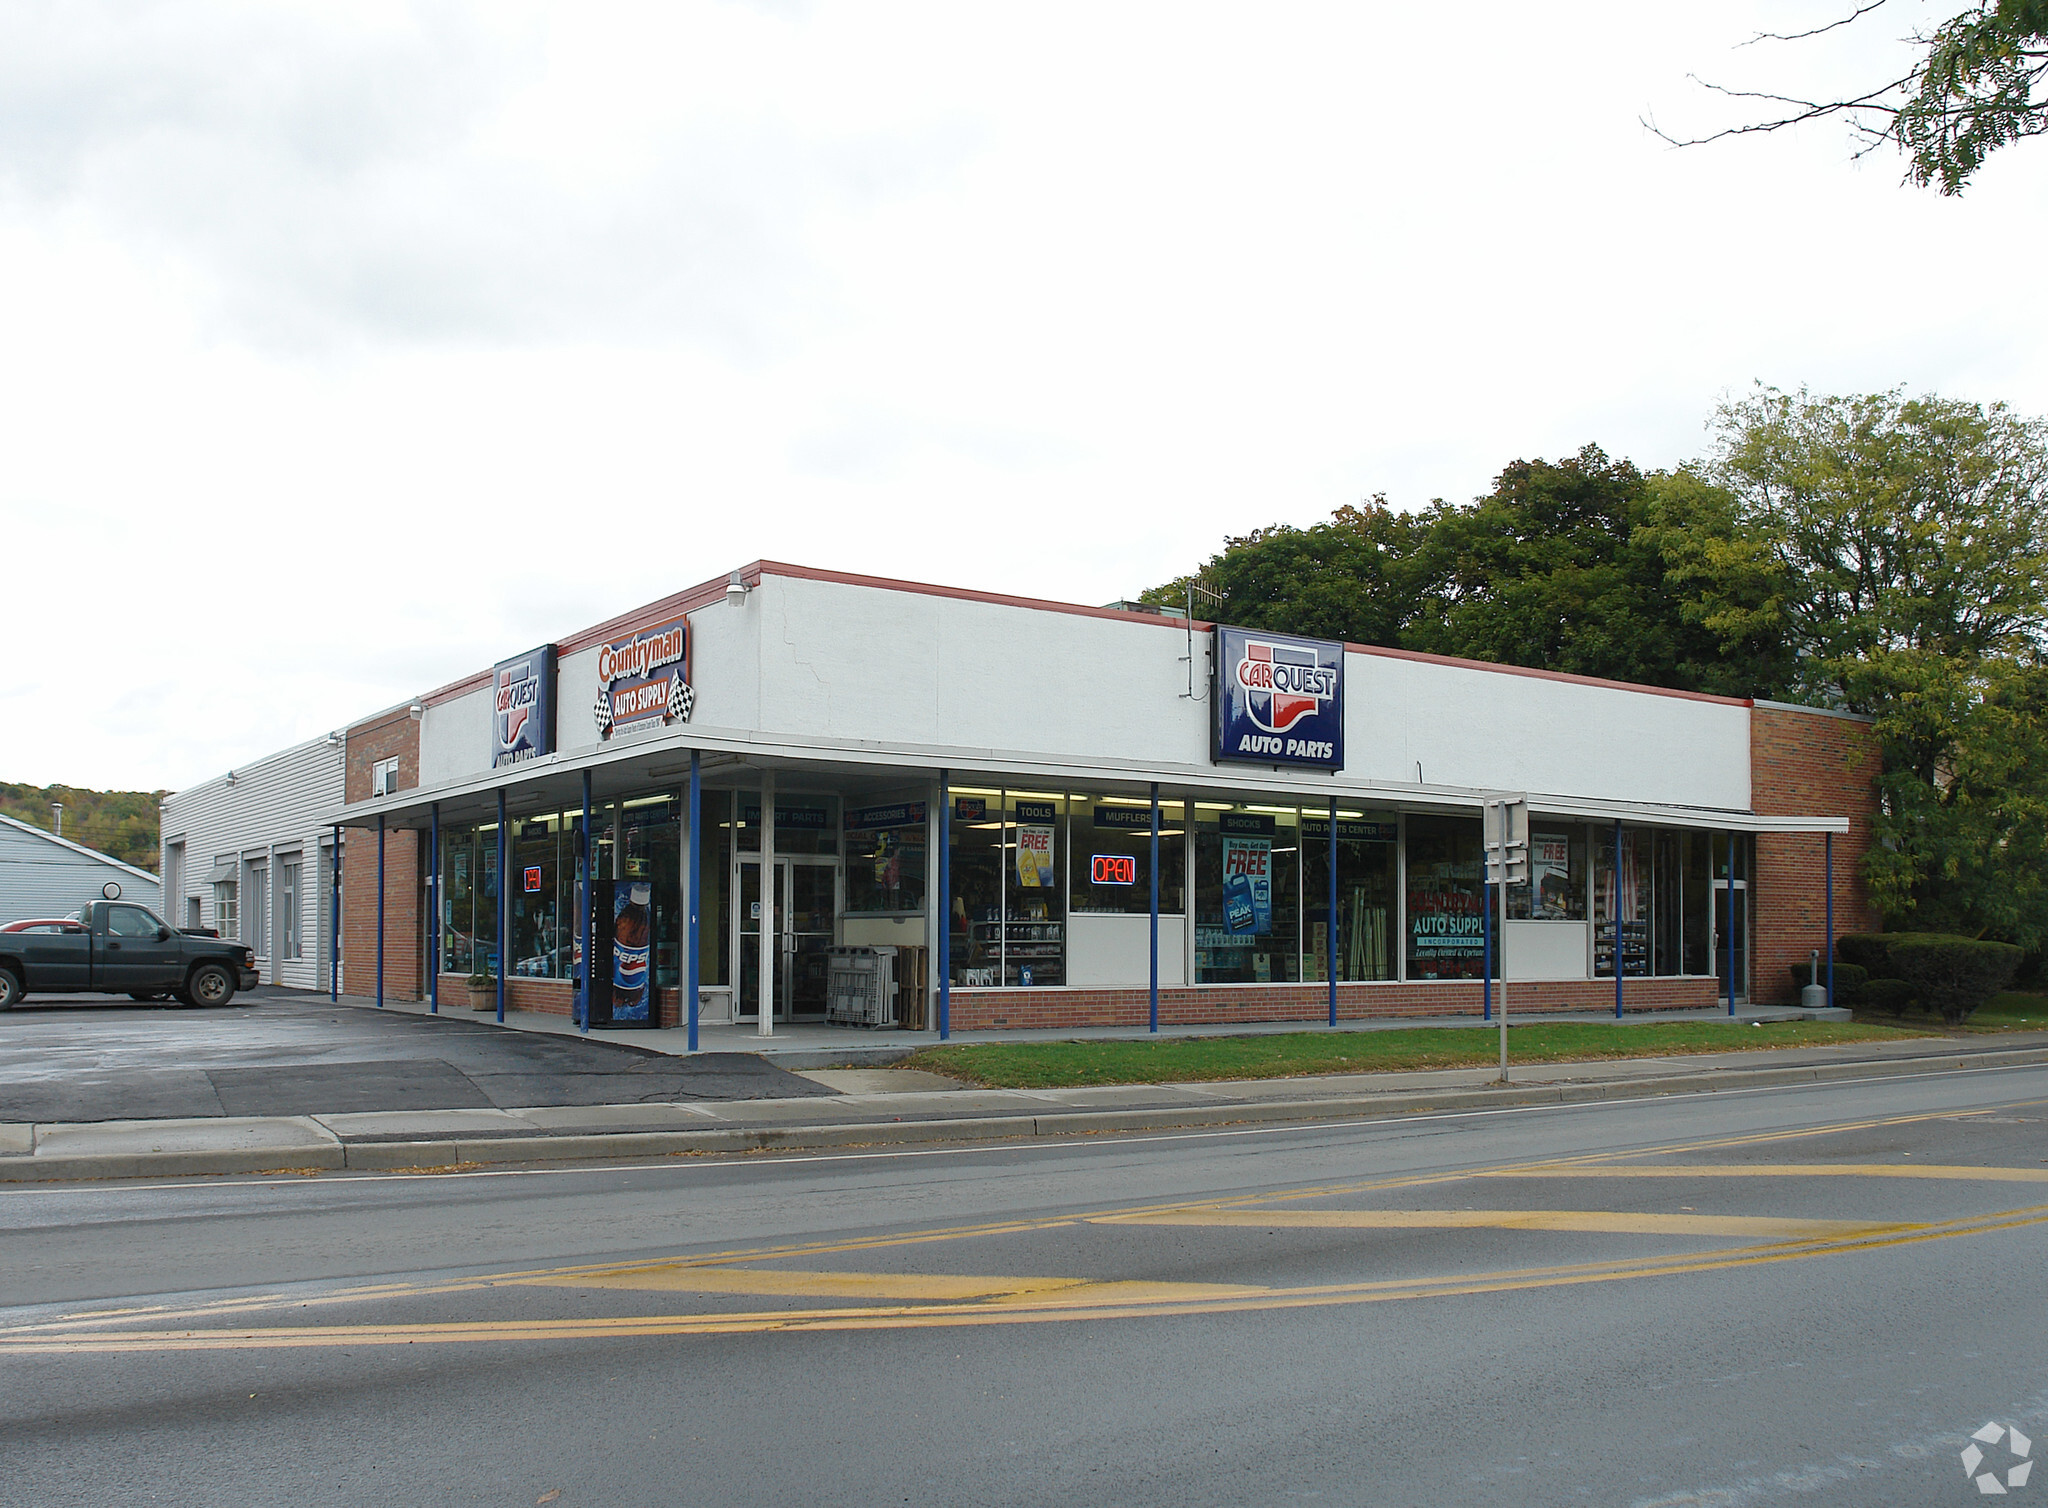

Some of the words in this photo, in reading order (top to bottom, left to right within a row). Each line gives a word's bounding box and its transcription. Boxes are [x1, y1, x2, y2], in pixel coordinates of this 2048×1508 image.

[598, 628, 682, 685] Countryman
[1239, 661, 1334, 696] CARQUEST
[496, 677, 538, 712] CARQUEST
[614, 690, 637, 717] AUTO
[637, 681, 668, 711] SUPPLY
[1238, 734, 1283, 755] AUTO
[1286, 738, 1334, 760] PARTS
[791, 812, 825, 823] PARTS
[863, 809, 906, 822] ACCESSORIES
[1020, 806, 1052, 818] TOOLS
[1105, 811, 1152, 823] MUFFLERS
[1227, 818, 1261, 829] SHOCKS
[1302, 822, 1322, 833] AUTO
[1348, 825, 1377, 835] CENTER
[1020, 833, 1050, 850] FREE
[1229, 841, 1238, 849] Buy
[1543, 843, 1566, 860] FREE
[1094, 857, 1133, 882] OPEN
[1226, 849, 1268, 876] FREE
[1229, 904, 1252, 920] PEAK
[1413, 916, 1446, 934] AUTO
[1449, 917, 1485, 934] SUPPL
[612, 946, 649, 964] PEPSI
